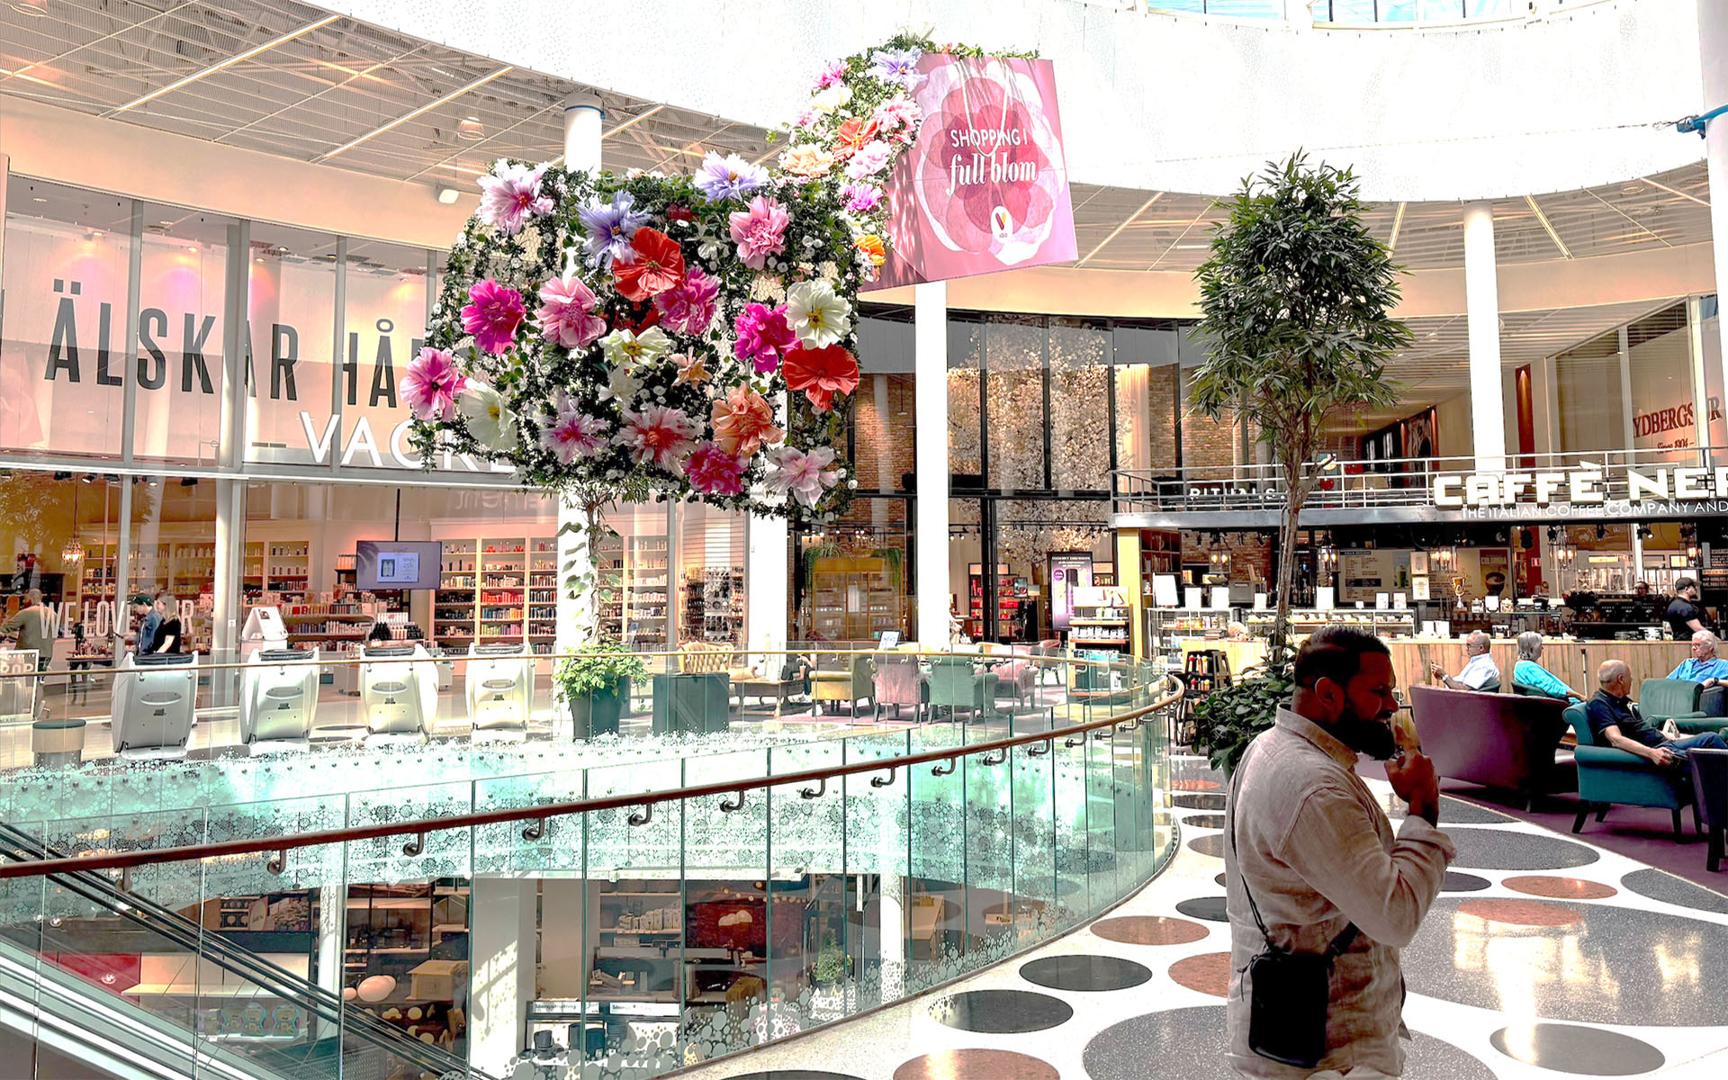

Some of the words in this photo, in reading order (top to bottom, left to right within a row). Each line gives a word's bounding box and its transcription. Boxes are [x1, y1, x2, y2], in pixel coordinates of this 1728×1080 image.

[950, 127, 1020, 148] SHOPPING
[945, 153, 986, 197] full
[990, 151, 1037, 184] blom
[341, 318, 424, 408] HÅ
[1433, 460, 1604, 507] CAFFÈ
[1462, 507, 1485, 519] THE
[1489, 505, 1542, 519] ITALIAN
[1546, 504, 1604, 517] COFFEE
[1606, 502, 1689, 516] COMPANY
[40, 601, 76, 639] WE
